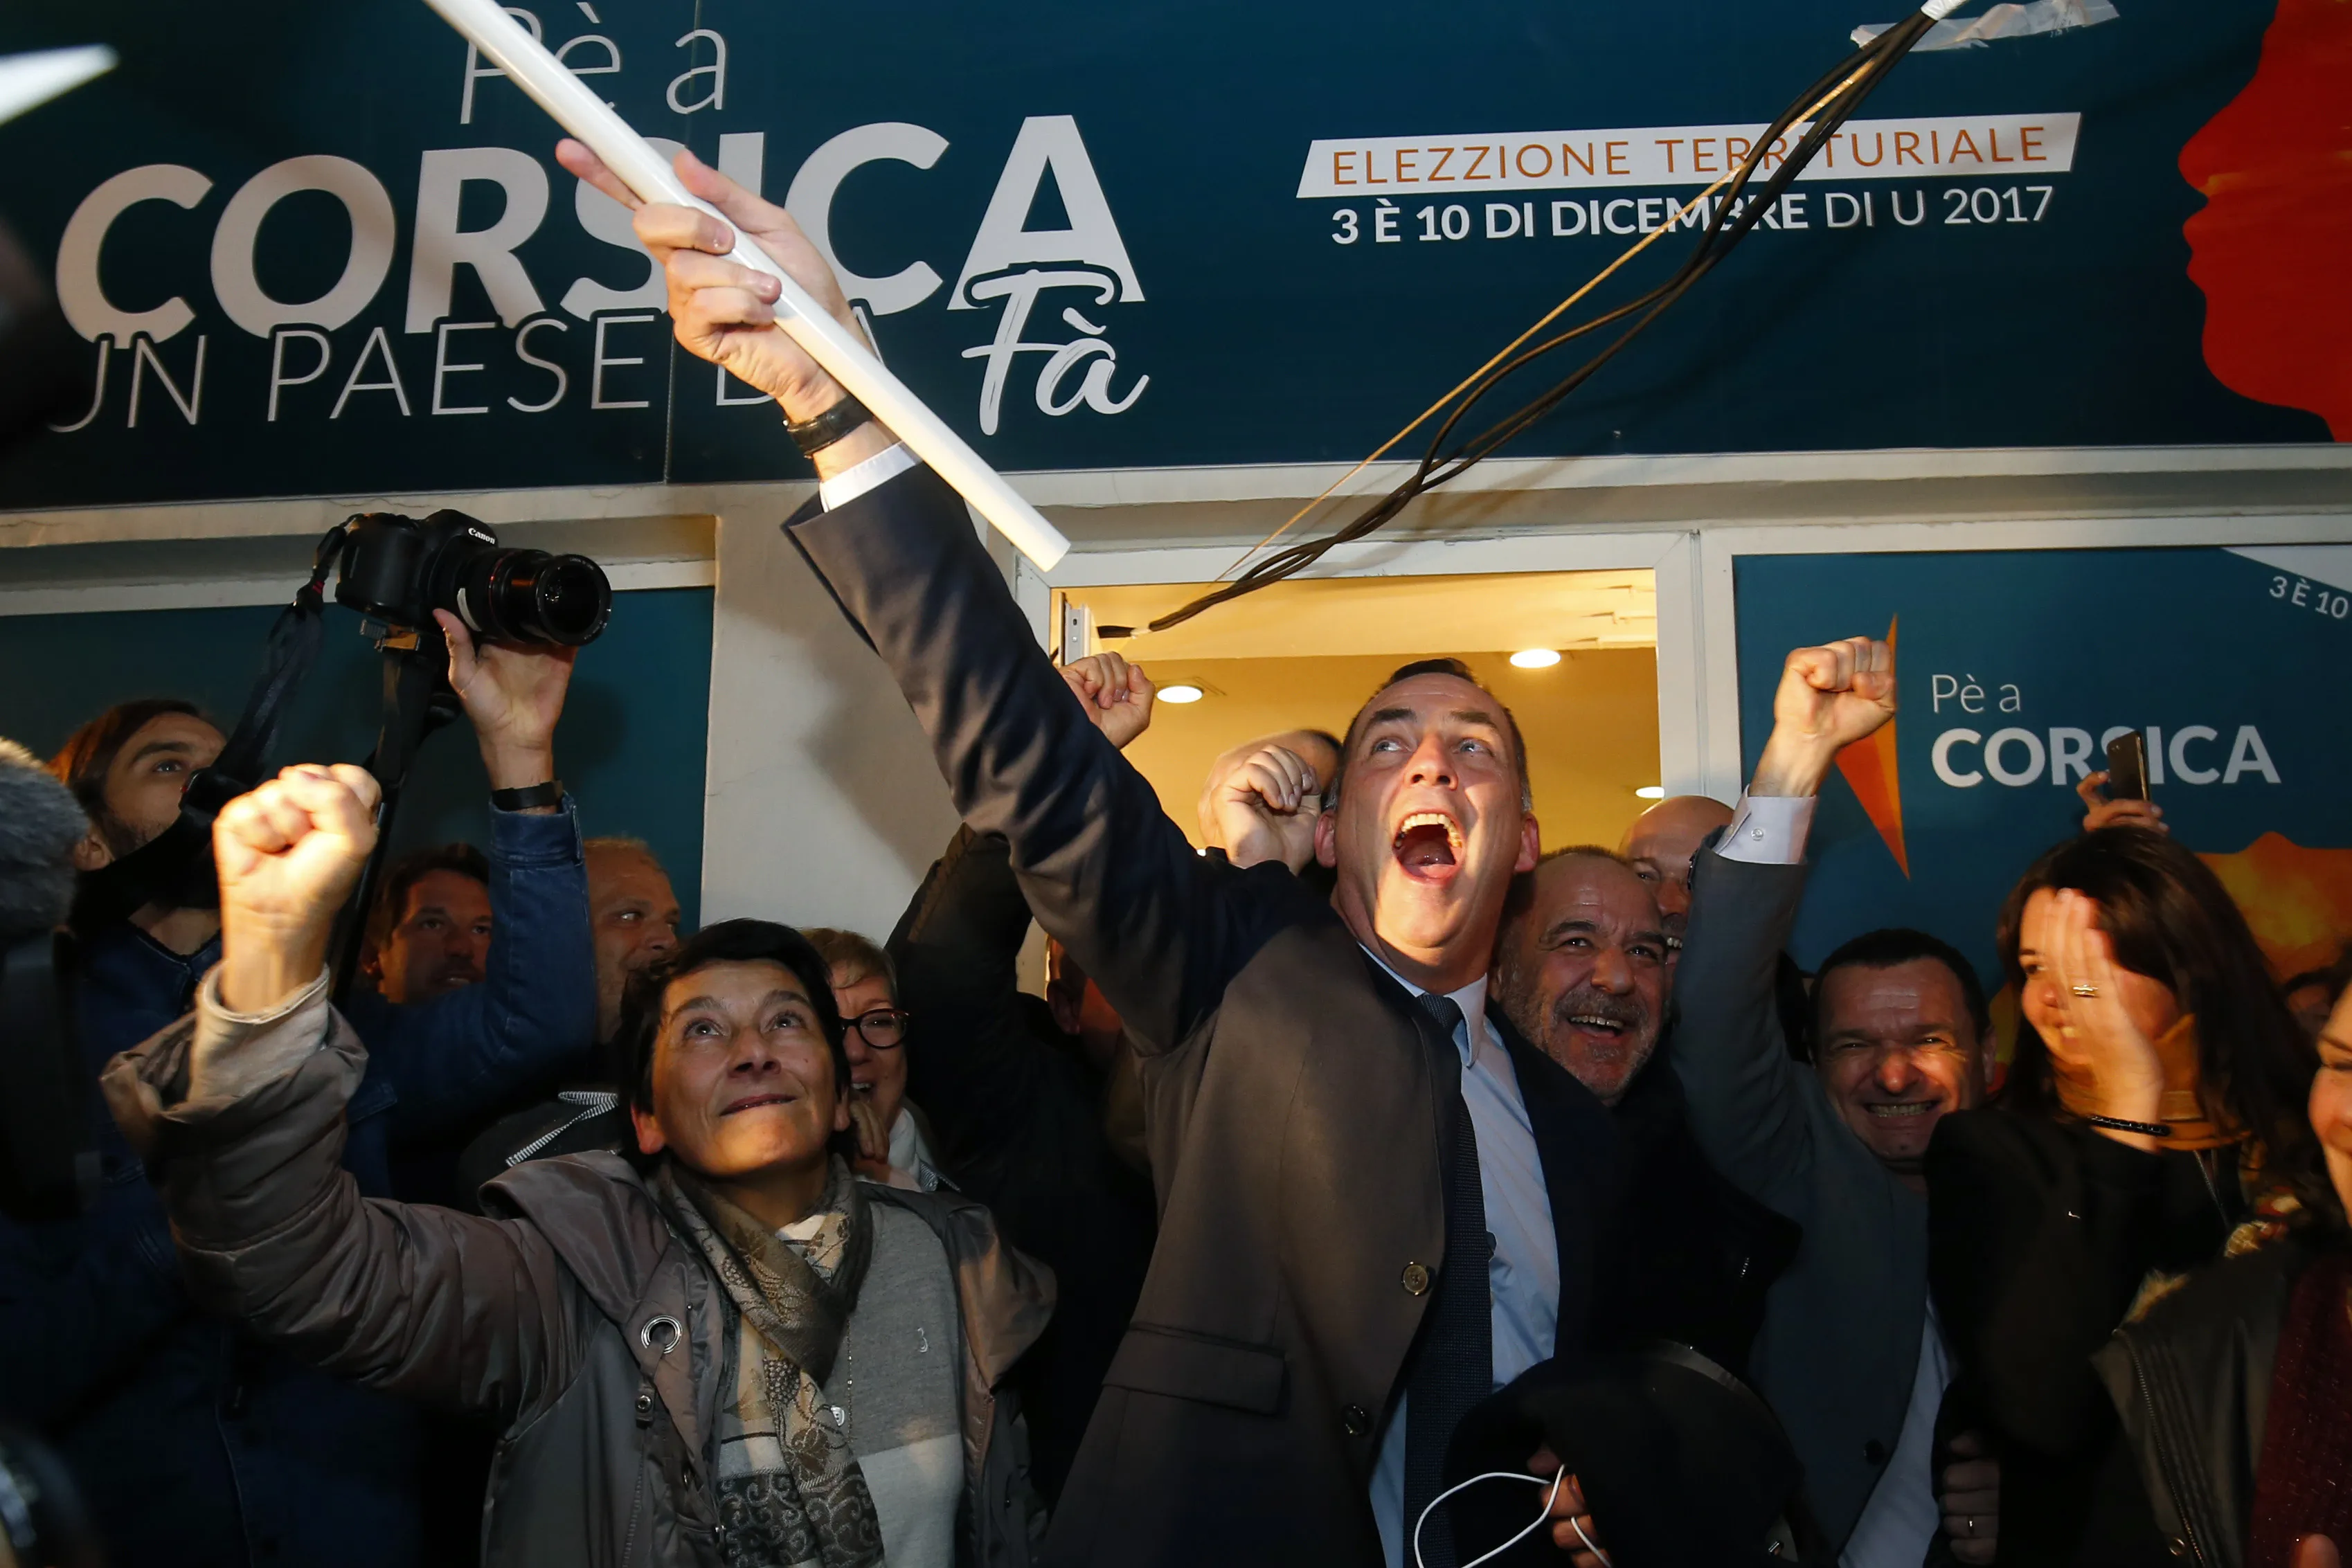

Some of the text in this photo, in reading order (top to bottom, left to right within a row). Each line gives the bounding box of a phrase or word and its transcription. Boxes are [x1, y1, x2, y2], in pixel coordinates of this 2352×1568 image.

[666, 29, 727, 115] a
[1334, 127, 2047, 186] ELEZZIONE TERRTURIALE
[56, 115, 1145, 349] CORSCA
[1331, 209, 1359, 244] 3
[1375, 199, 1401, 243] È
[1416, 205, 1471, 242] 10
[1485, 202, 1534, 240] DI
[1825, 192, 1874, 228] DI
[1892, 190, 1925, 226] U
[1943, 186, 2053, 224] 2017
[268, 315, 654, 422] PAESE
[962, 269, 1149, 435] Fà
[468, 528, 496, 545] Canon
[2269, 576, 2349, 619] 3 È 10
[1932, 674, 2020, 714] Pè a
[1932, 725, 2281, 788] CORICA
